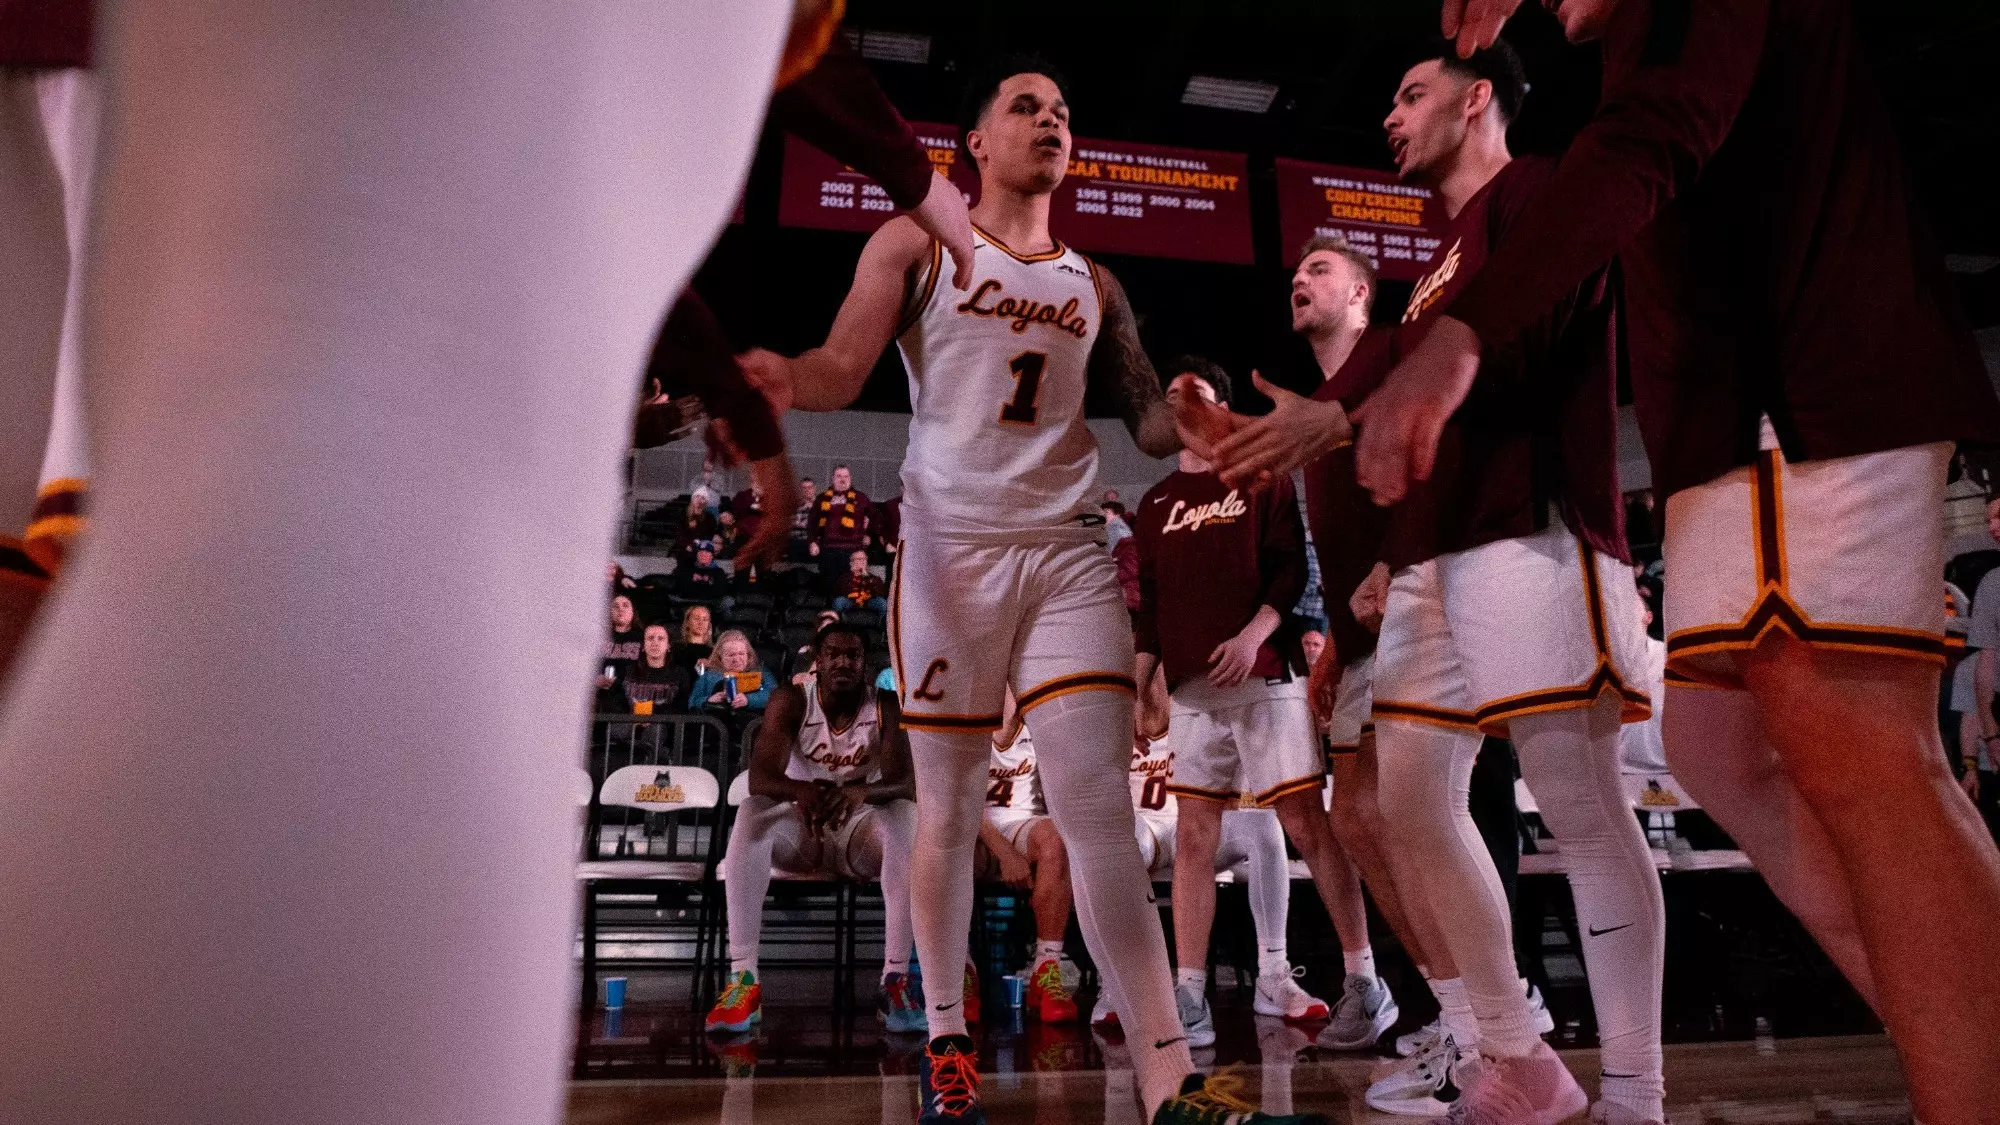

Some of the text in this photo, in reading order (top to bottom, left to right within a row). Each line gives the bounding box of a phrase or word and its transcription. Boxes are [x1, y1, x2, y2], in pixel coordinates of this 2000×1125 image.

[1077, 149, 1208, 170] WOMEN'S VOLLEYBALL
[1066, 160, 1239, 190] CAA TOURNAMENT
[820, 181, 854, 194] 2002
[1311, 176, 1432, 198] WOMEN'S VOLLEYBALL
[819, 195, 854, 208] 2014
[1325, 188, 1424, 212] CONFERENCE
[1331, 203, 1421, 226] CHAMPIONS
[957, 278, 1088, 338] Loyola
[998, 350, 1048, 426] 1
[1162, 489, 1247, 535] Loyola
[988, 757, 1032, 779] oyola
